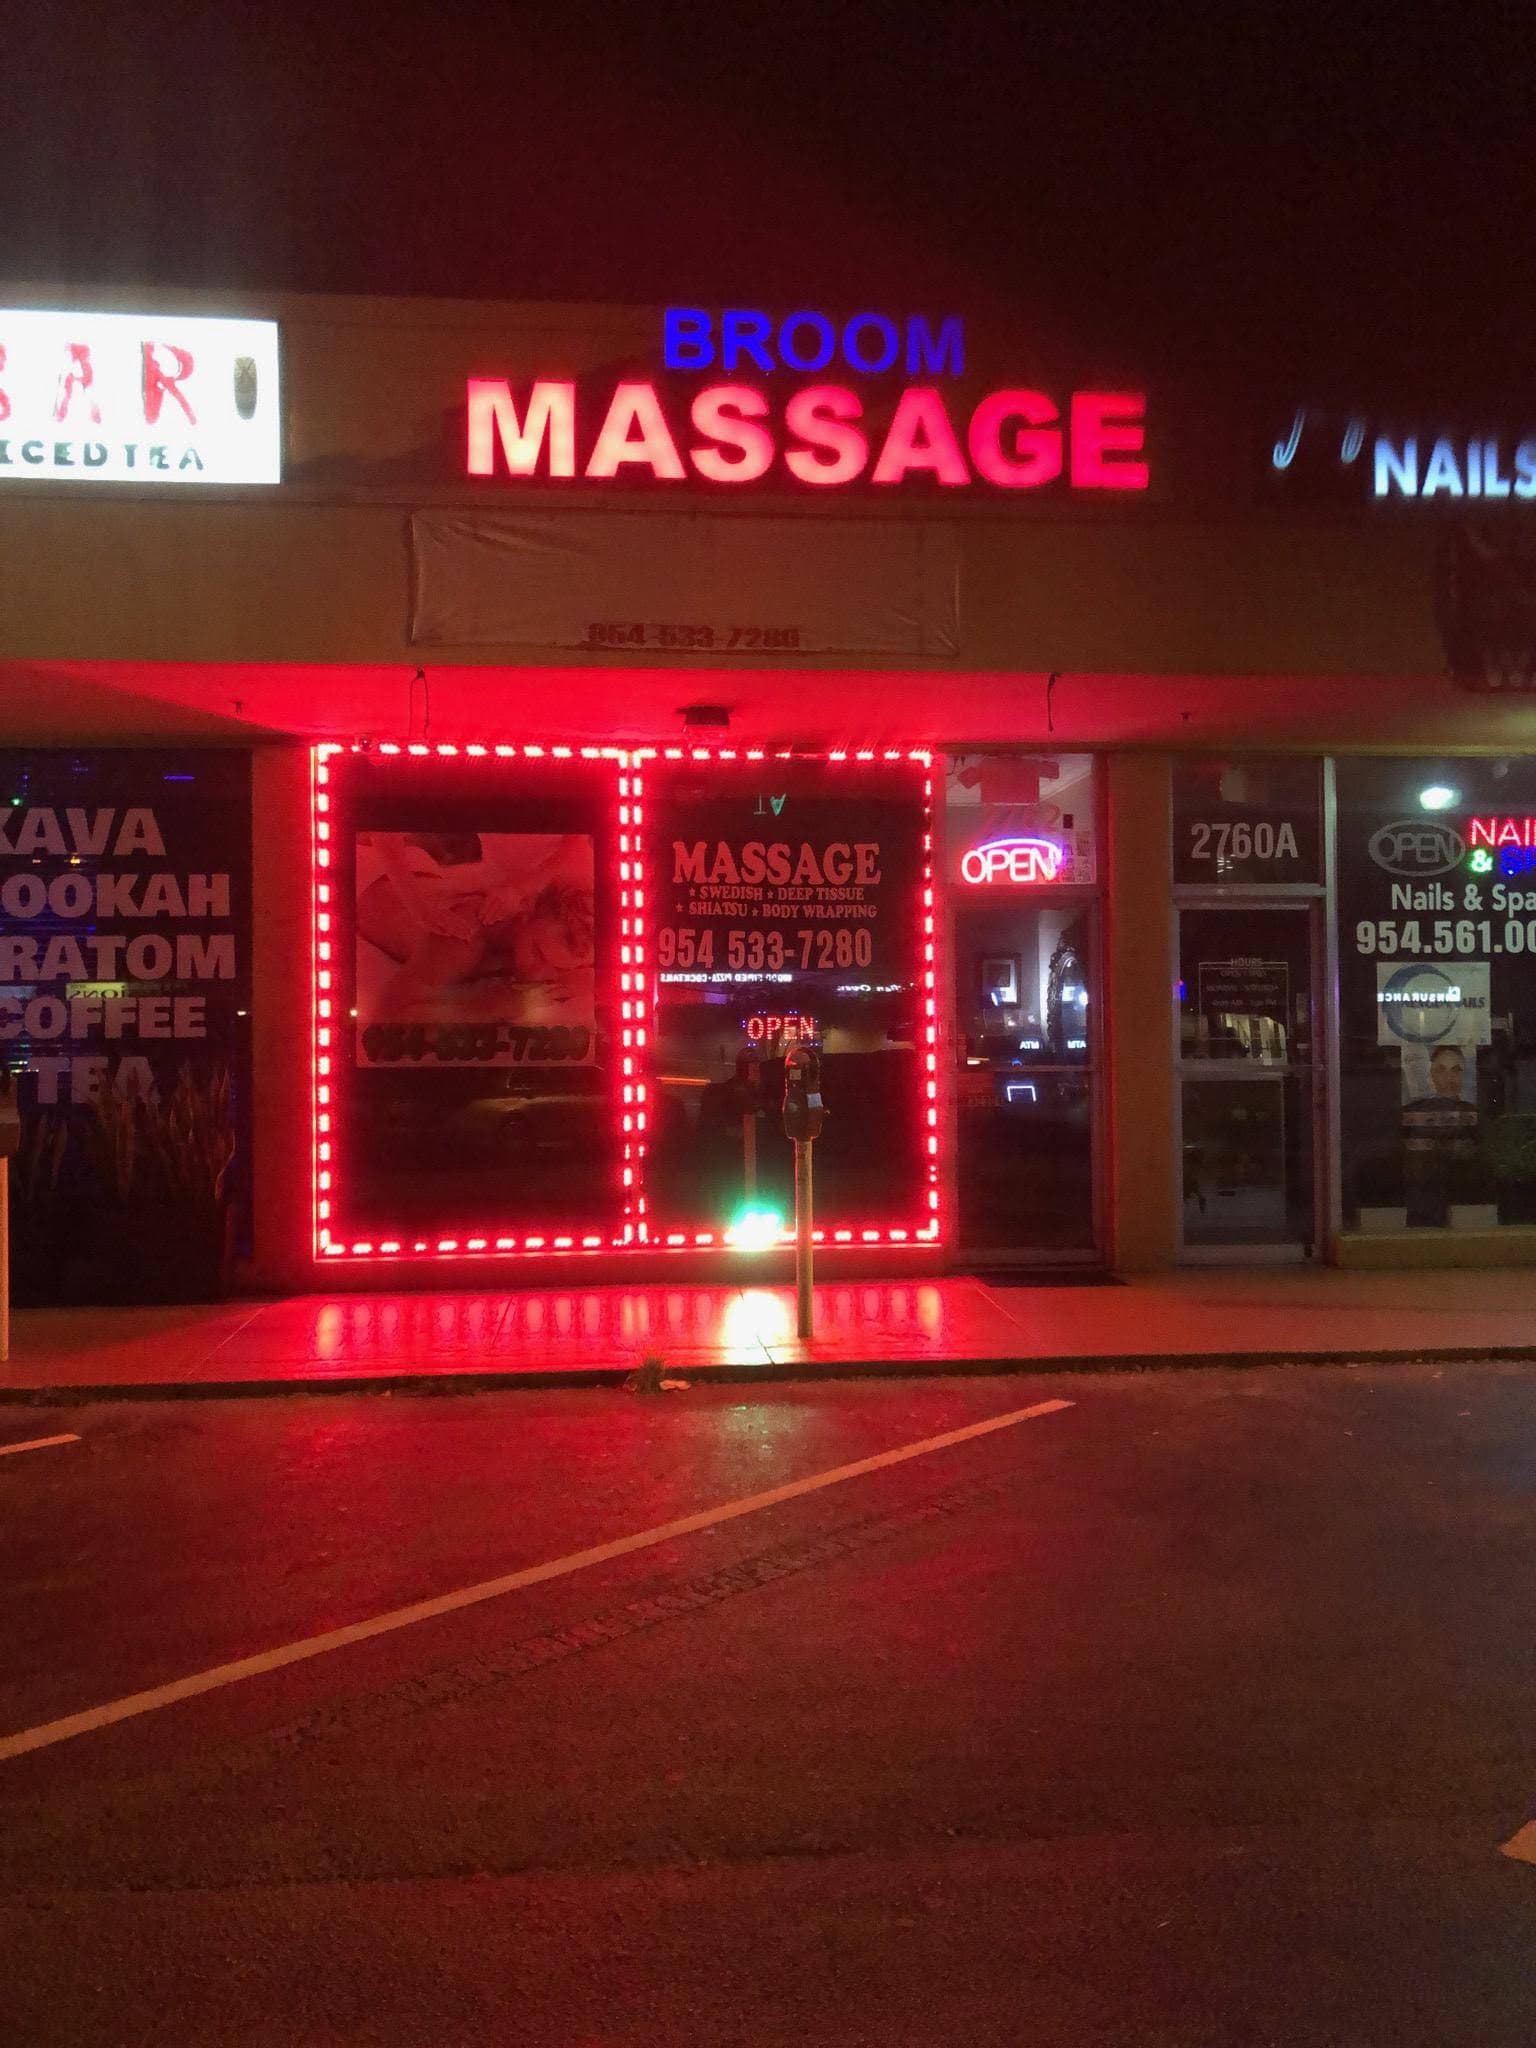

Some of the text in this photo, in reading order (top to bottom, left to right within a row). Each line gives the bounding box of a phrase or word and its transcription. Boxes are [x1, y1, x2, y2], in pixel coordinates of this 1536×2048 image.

[664, 308, 965, 377] BROOM
[0, 340, 197, 426] AR
[467, 379, 1149, 490] MASSAGE
[1190, 822, 1299, 859] 2760A
[1376, 831, 1458, 864] OPEN
[672, 841, 882, 886] MASSAGE
[961, 850, 1058, 884] OPEN
[1471, 848, 1493, 873] &
[688, 902, 878, 919] SHIATSU BODY WRAPPING
[699, 886, 865, 901] SWEDISH DEEP TISSUE
[1391, 883, 1456, 911] Nails
[1463, 883, 1483, 911] &
[658, 928, 873, 970] 954 533-7280
[747, 1016, 815, 1041] OPEN
